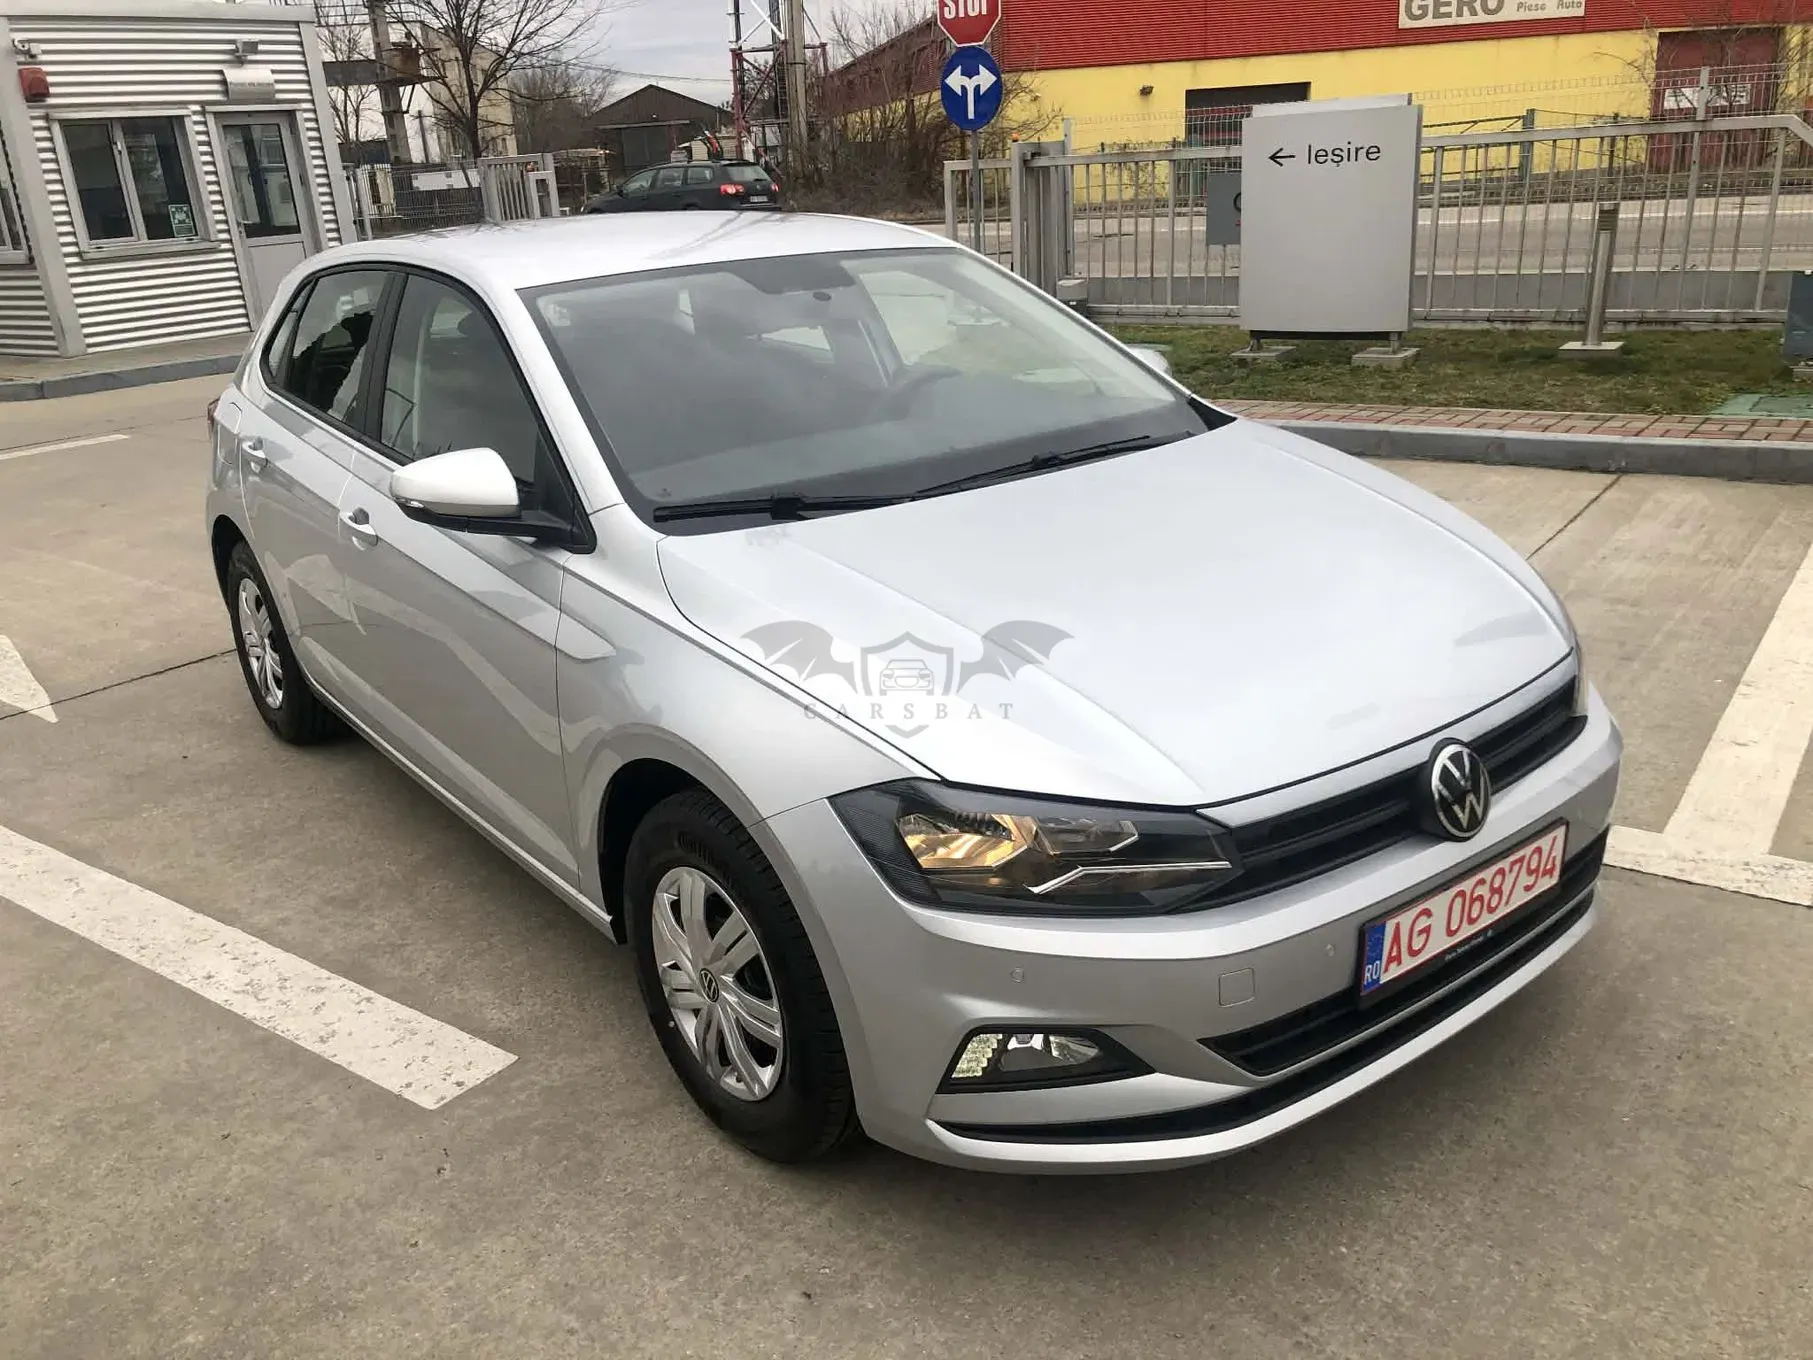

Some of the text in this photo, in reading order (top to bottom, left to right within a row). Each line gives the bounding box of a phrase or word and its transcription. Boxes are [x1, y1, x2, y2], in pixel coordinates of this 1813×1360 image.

[1404, 0, 1504, 21] GERO
[1556, 0, 1583, 10] Auto
[1383, 834, 1557, 975] AG 068794
[1364, 960, 1380, 985] RO
